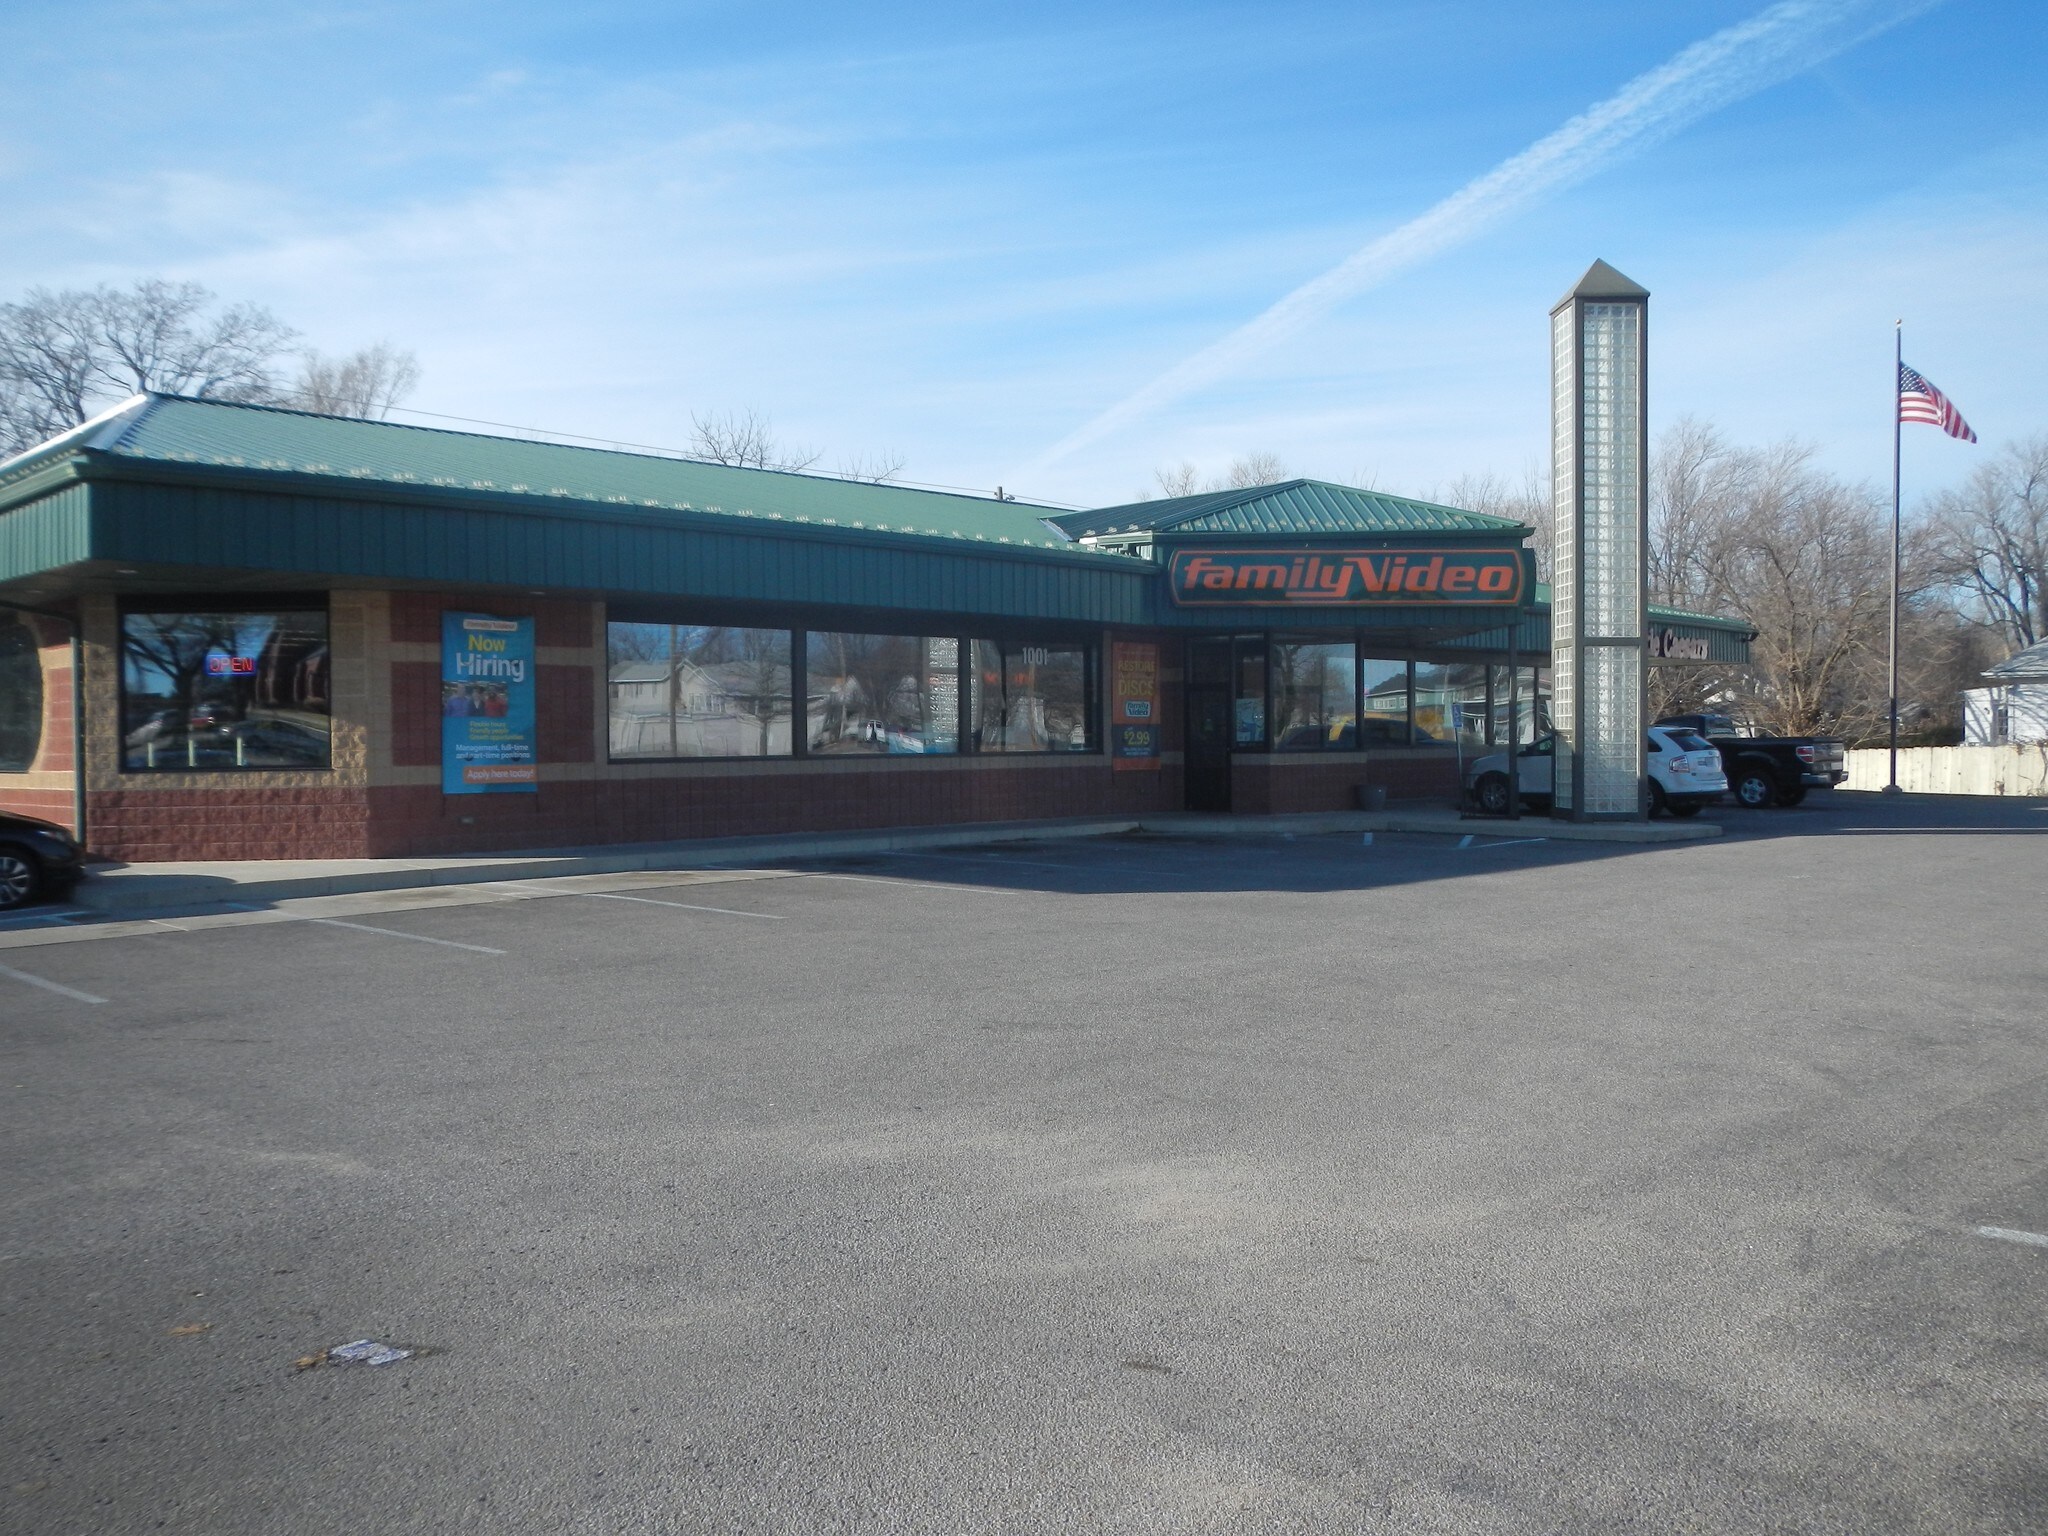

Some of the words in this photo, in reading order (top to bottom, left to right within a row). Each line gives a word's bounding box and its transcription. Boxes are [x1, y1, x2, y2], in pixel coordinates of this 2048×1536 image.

[468, 634, 505, 651] Now
[1022, 647, 1048, 665] 1001
[209, 657, 254, 672] OPEN
[456, 652, 524, 682] Hiring
[1118, 680, 1154, 696] DISCS
[1123, 730, 1150, 746] $2.99
[467, 769, 490, 780] Apply
[491, 768, 508, 778] here
